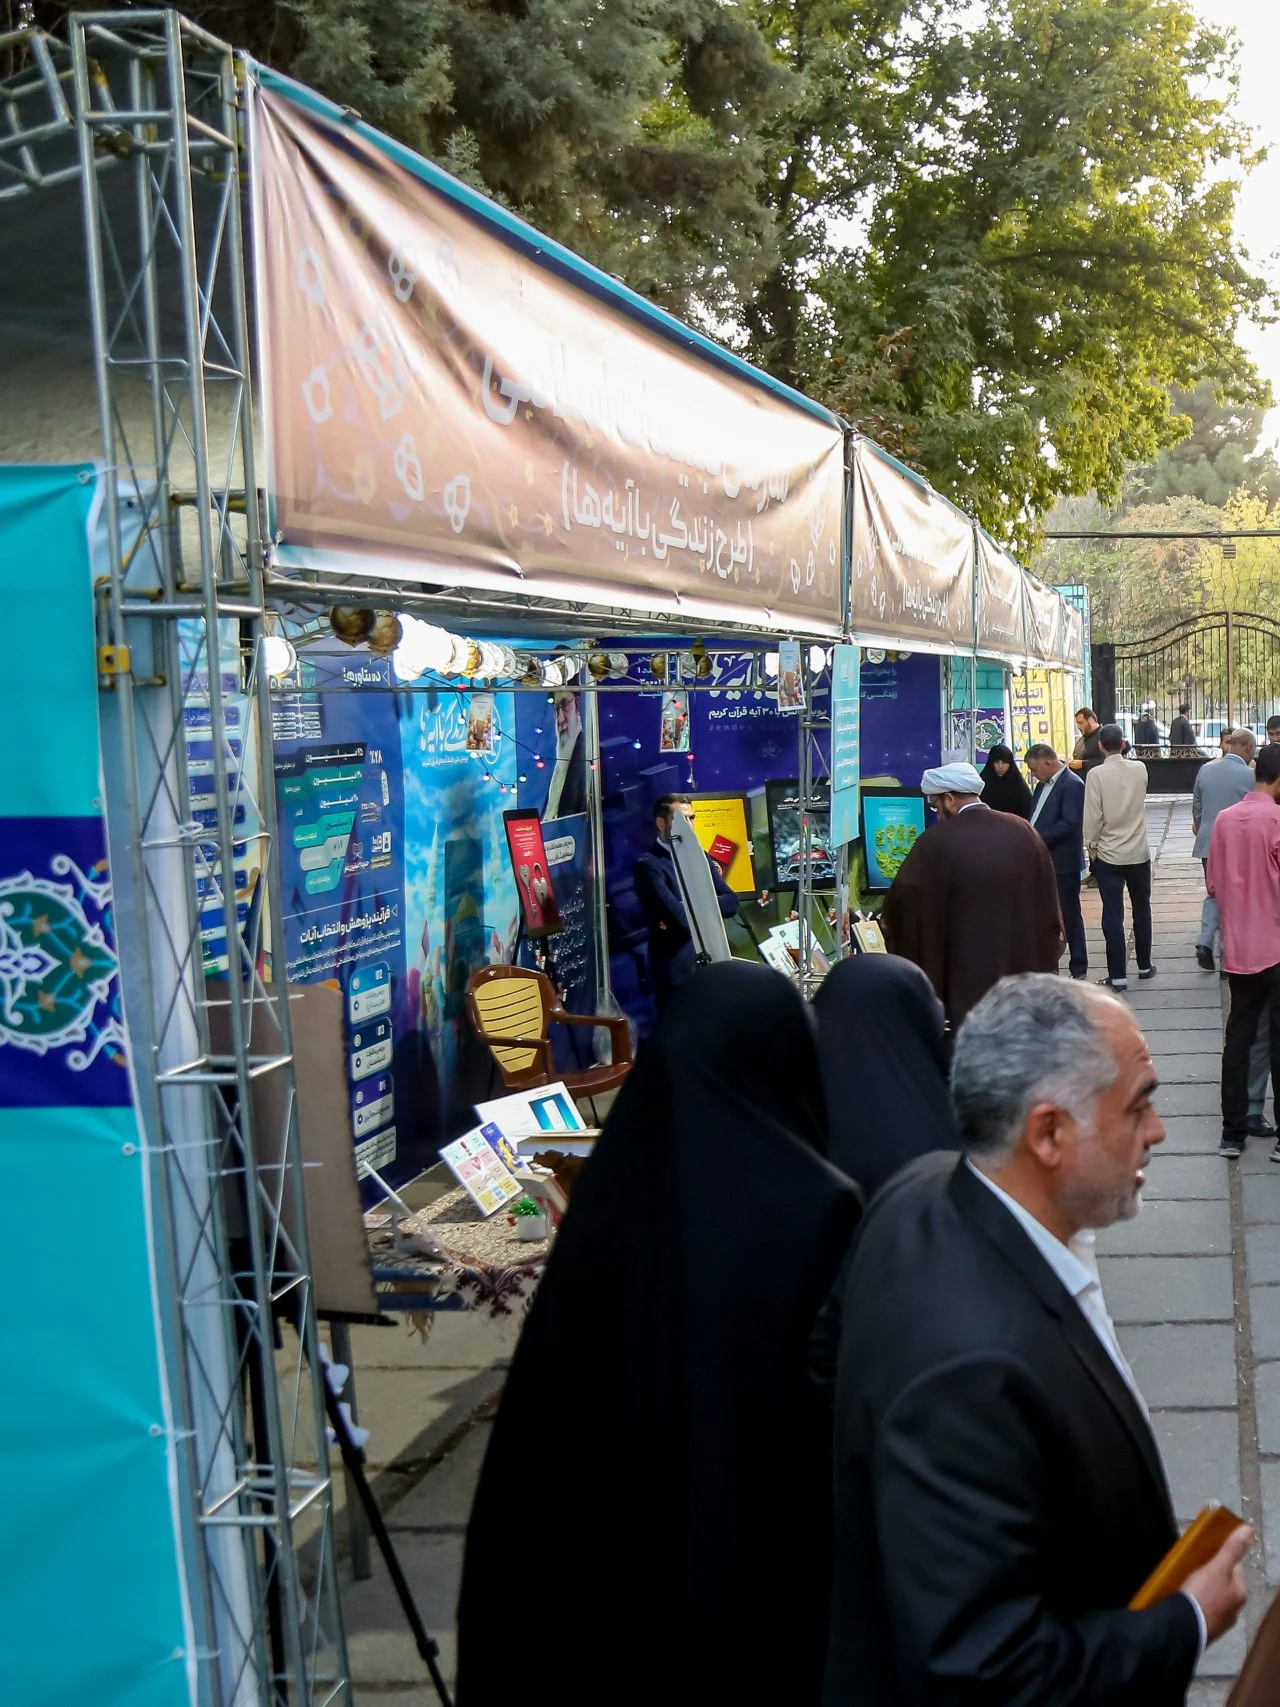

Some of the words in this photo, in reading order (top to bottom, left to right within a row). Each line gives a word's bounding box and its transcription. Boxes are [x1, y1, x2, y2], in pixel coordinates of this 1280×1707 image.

[636, 489, 650, 556] با
[652, 496, 714, 575] زندگی
[708, 707, 729, 720] کریم
[728, 706, 748, 718] قرآن
[748, 706, 761, 718] آیه
[346, 912, 372, 933] پژوهش
[372, 905, 391, 925] فرآیند
[300, 925, 317, 944] آیات
[316, 920, 341, 942] انتخاب
[340, 923, 346, 935] و
